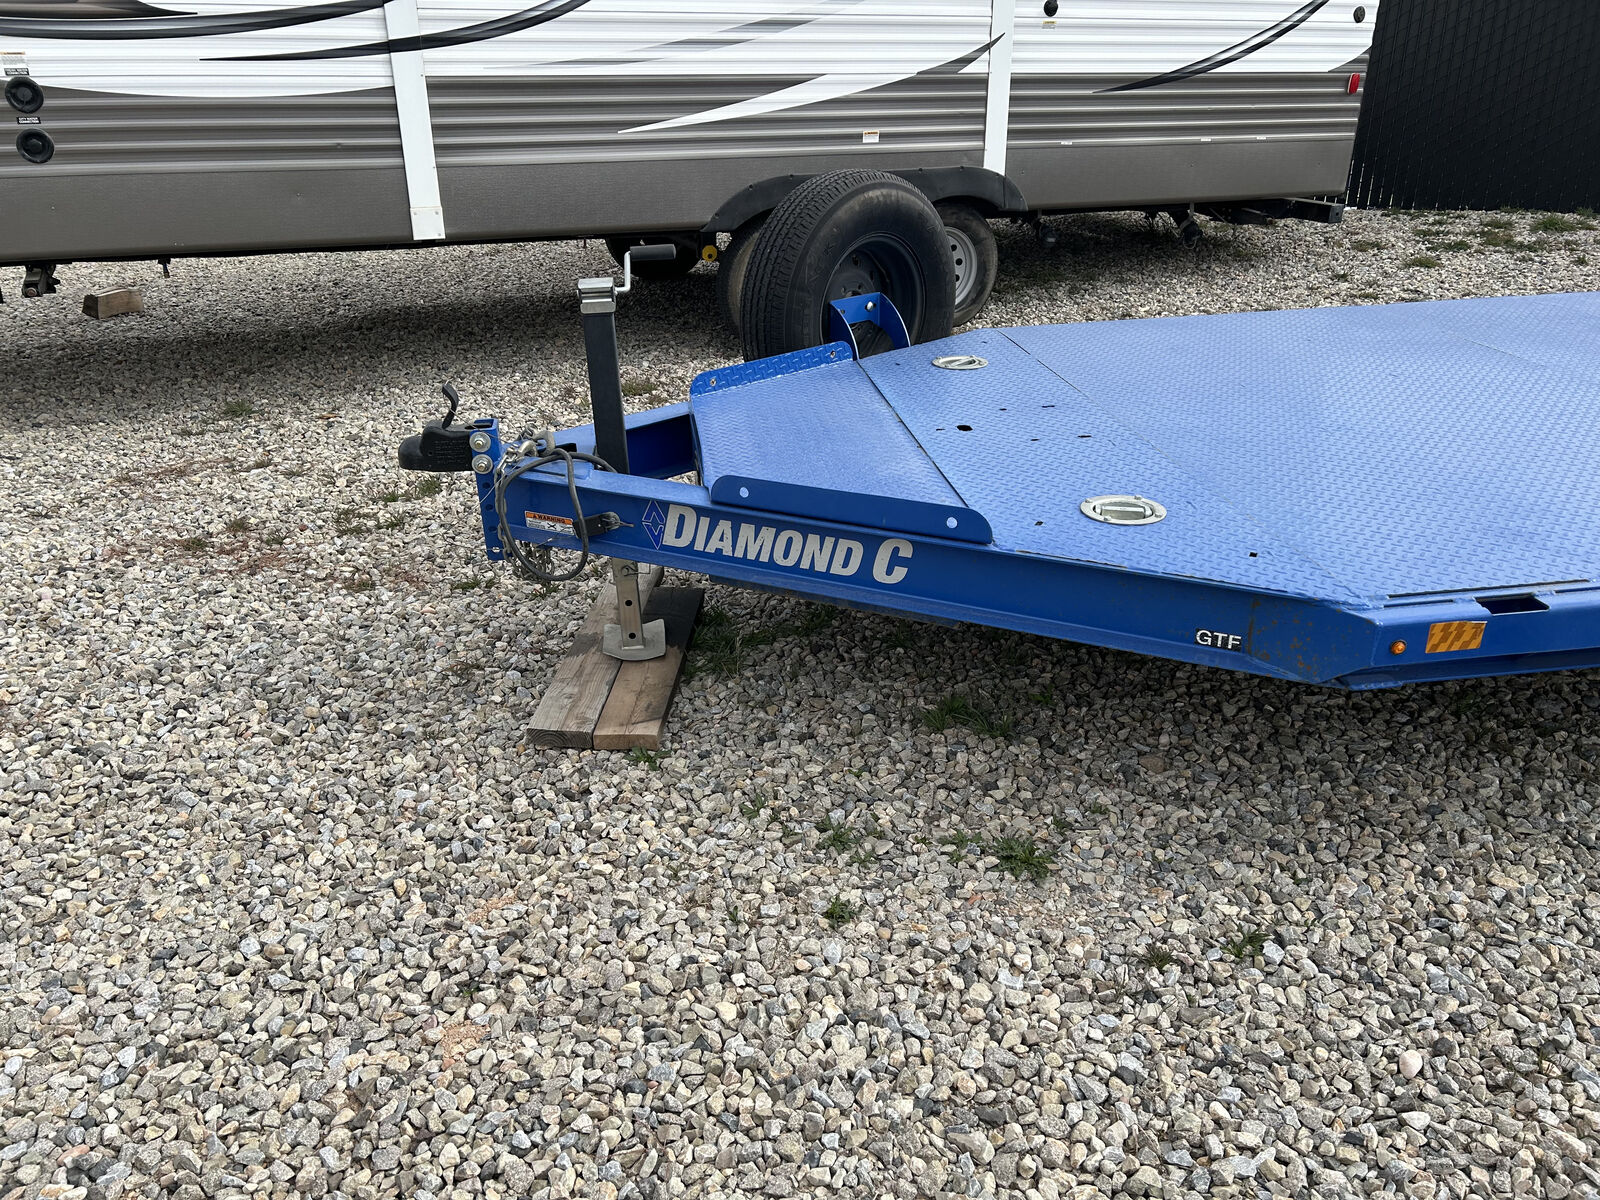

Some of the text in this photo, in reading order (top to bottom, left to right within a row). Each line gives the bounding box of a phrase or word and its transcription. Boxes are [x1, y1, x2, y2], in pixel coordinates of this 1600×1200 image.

[537, 514, 566, 524] WARNING
[662, 503, 914, 585] DIAMOND C
[1195, 629, 1242, 650] GTF
